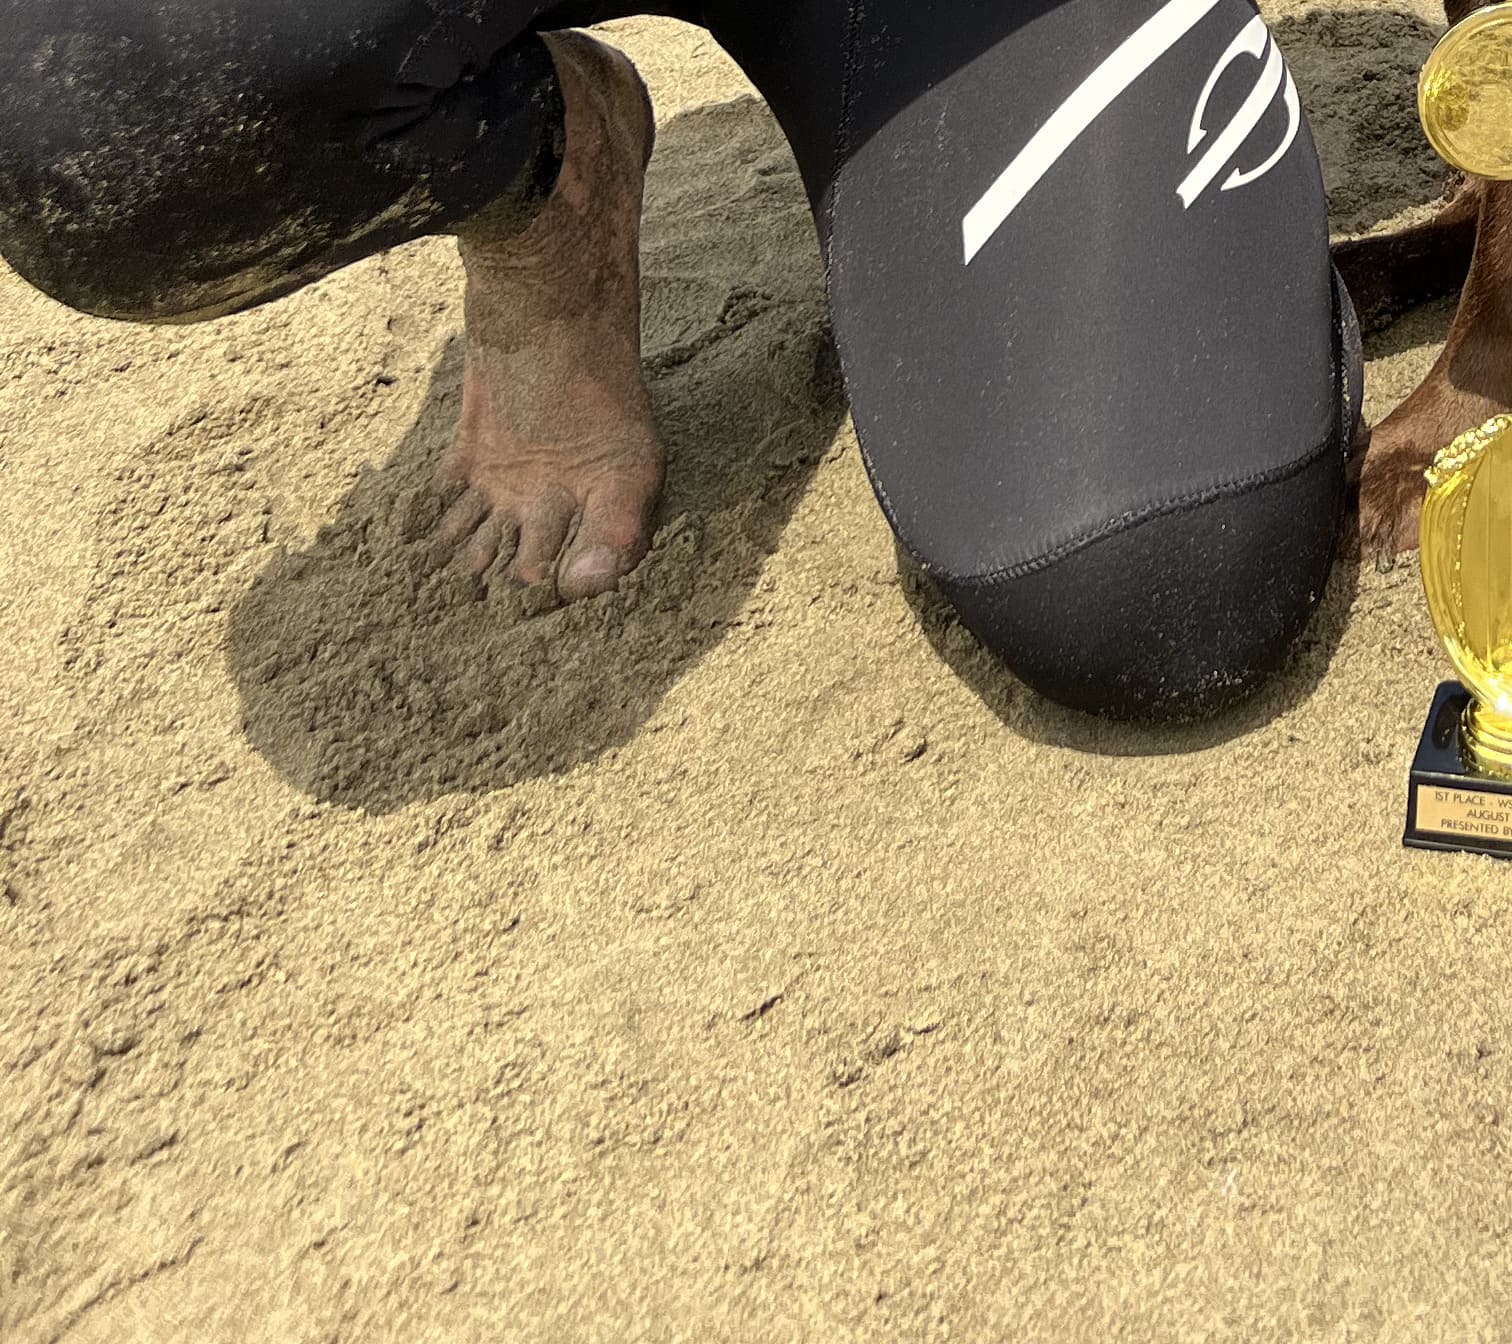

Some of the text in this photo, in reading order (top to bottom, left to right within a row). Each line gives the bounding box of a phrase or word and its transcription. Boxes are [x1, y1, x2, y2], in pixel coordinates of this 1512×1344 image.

[1434, 791, 1449, 801] 1ST
[1453, 793, 1485, 805] PLACE
[1466, 809, 1510, 823] AUGUST
[1440, 818, 1499, 834] PRESENTED
